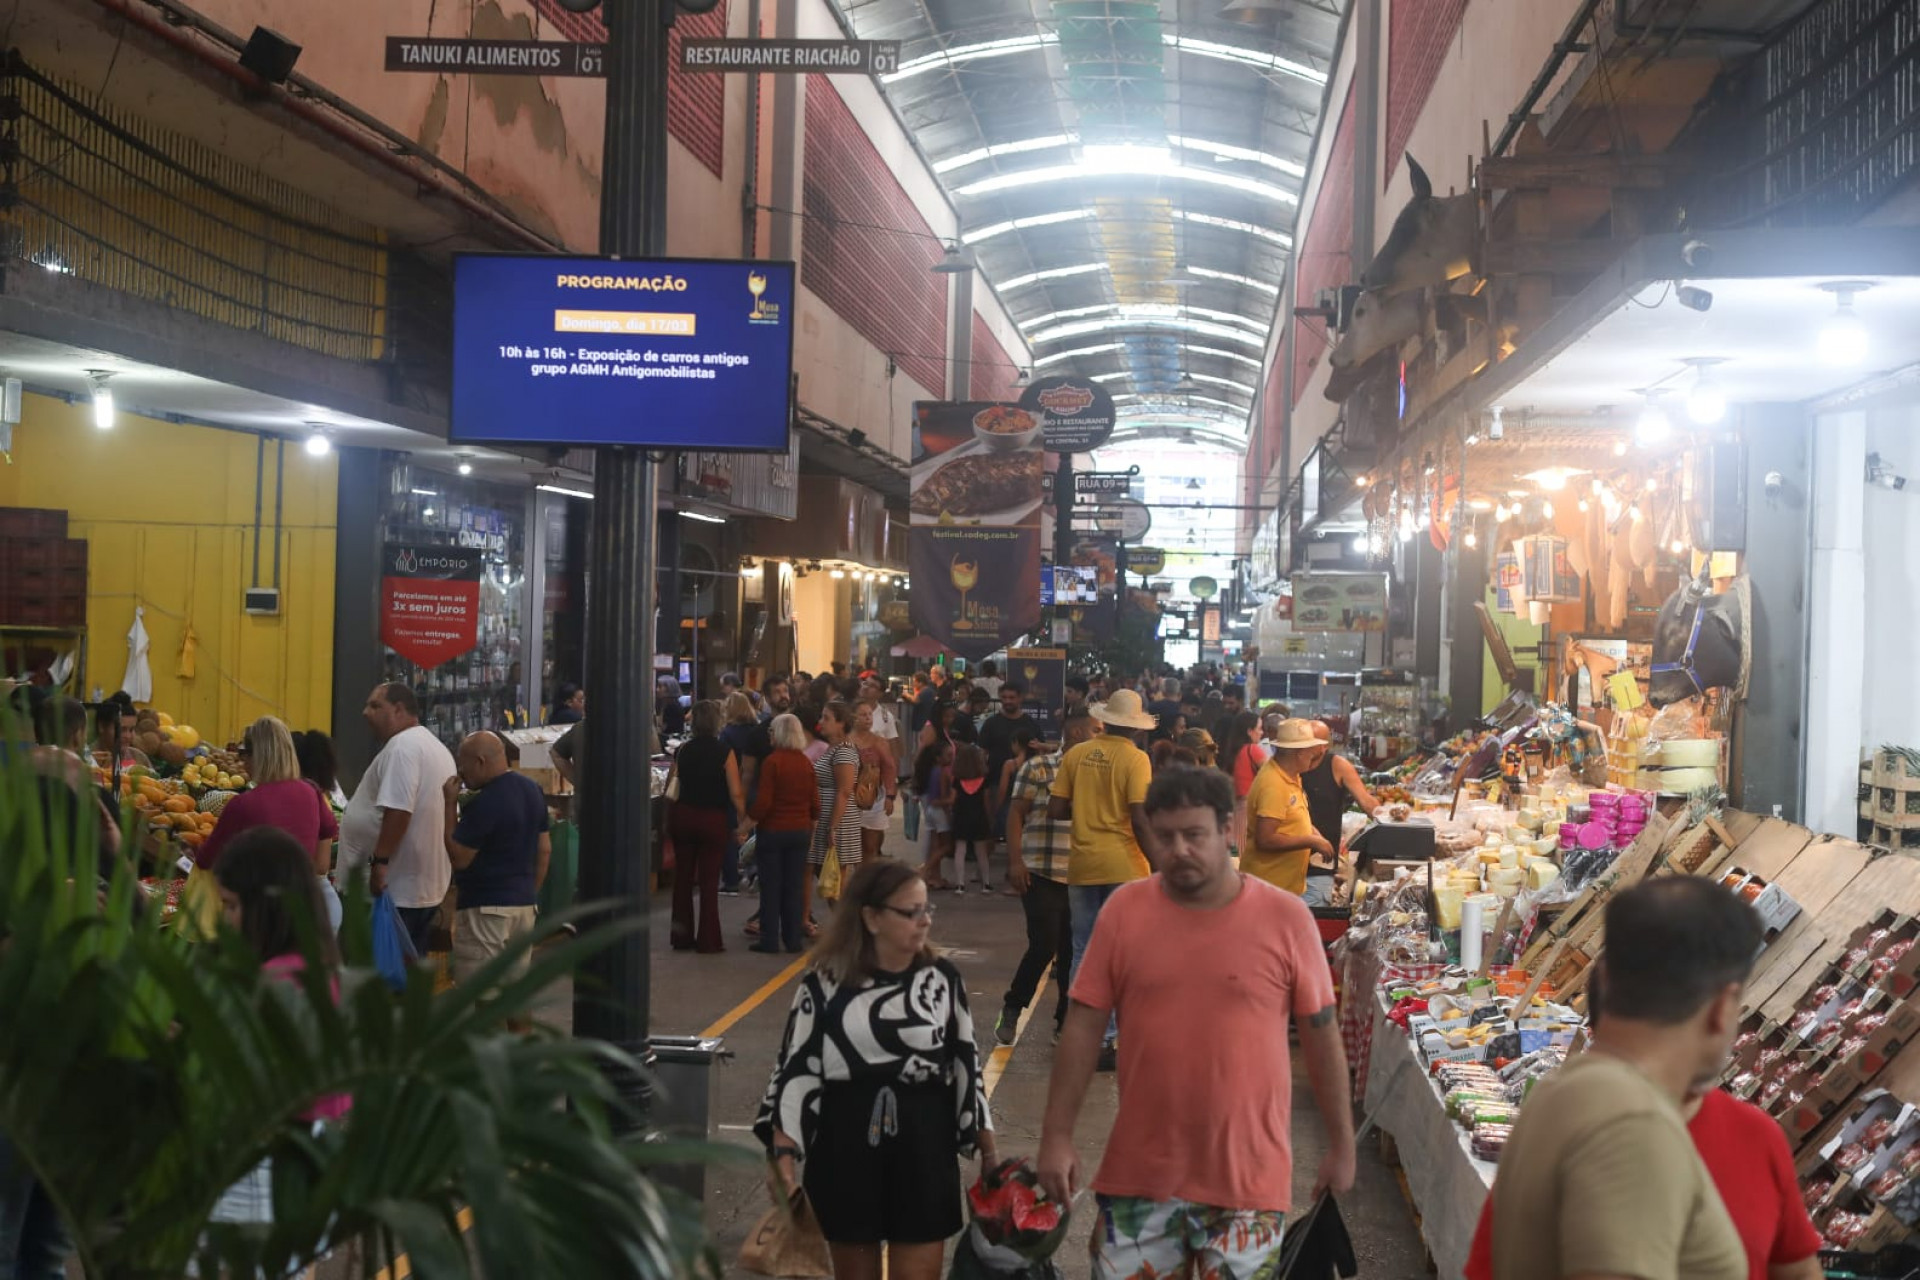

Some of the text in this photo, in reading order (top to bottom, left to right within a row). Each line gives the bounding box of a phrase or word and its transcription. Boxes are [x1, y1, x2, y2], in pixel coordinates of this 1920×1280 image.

[401, 44, 561, 67] TANUKI ALIMENTOS
[685, 45, 861, 66] RESTAURANTE RIACHÃO
[874, 55, 896, 71] 01
[581, 57, 602, 73] 01
[556, 274, 687, 292] PROGRAMAÇÃO
[561, 316, 688, 333] Domingo, dia 17/03
[499, 346, 522, 359] 10h
[525, 346, 540, 359] às
[543, 347, 566, 360] 16h
[578, 348, 640, 363] Exposição
[643, 350, 659, 363] de
[661, 353, 700, 363] carros
[703, 352, 749, 367] antigos
[531, 363, 716, 379] grupo AGMH Antigomobilistas
[1079, 479, 1116, 488] RUA 09
[454, 594, 467, 602] até
[392, 601, 467, 615] 3x sem juros
